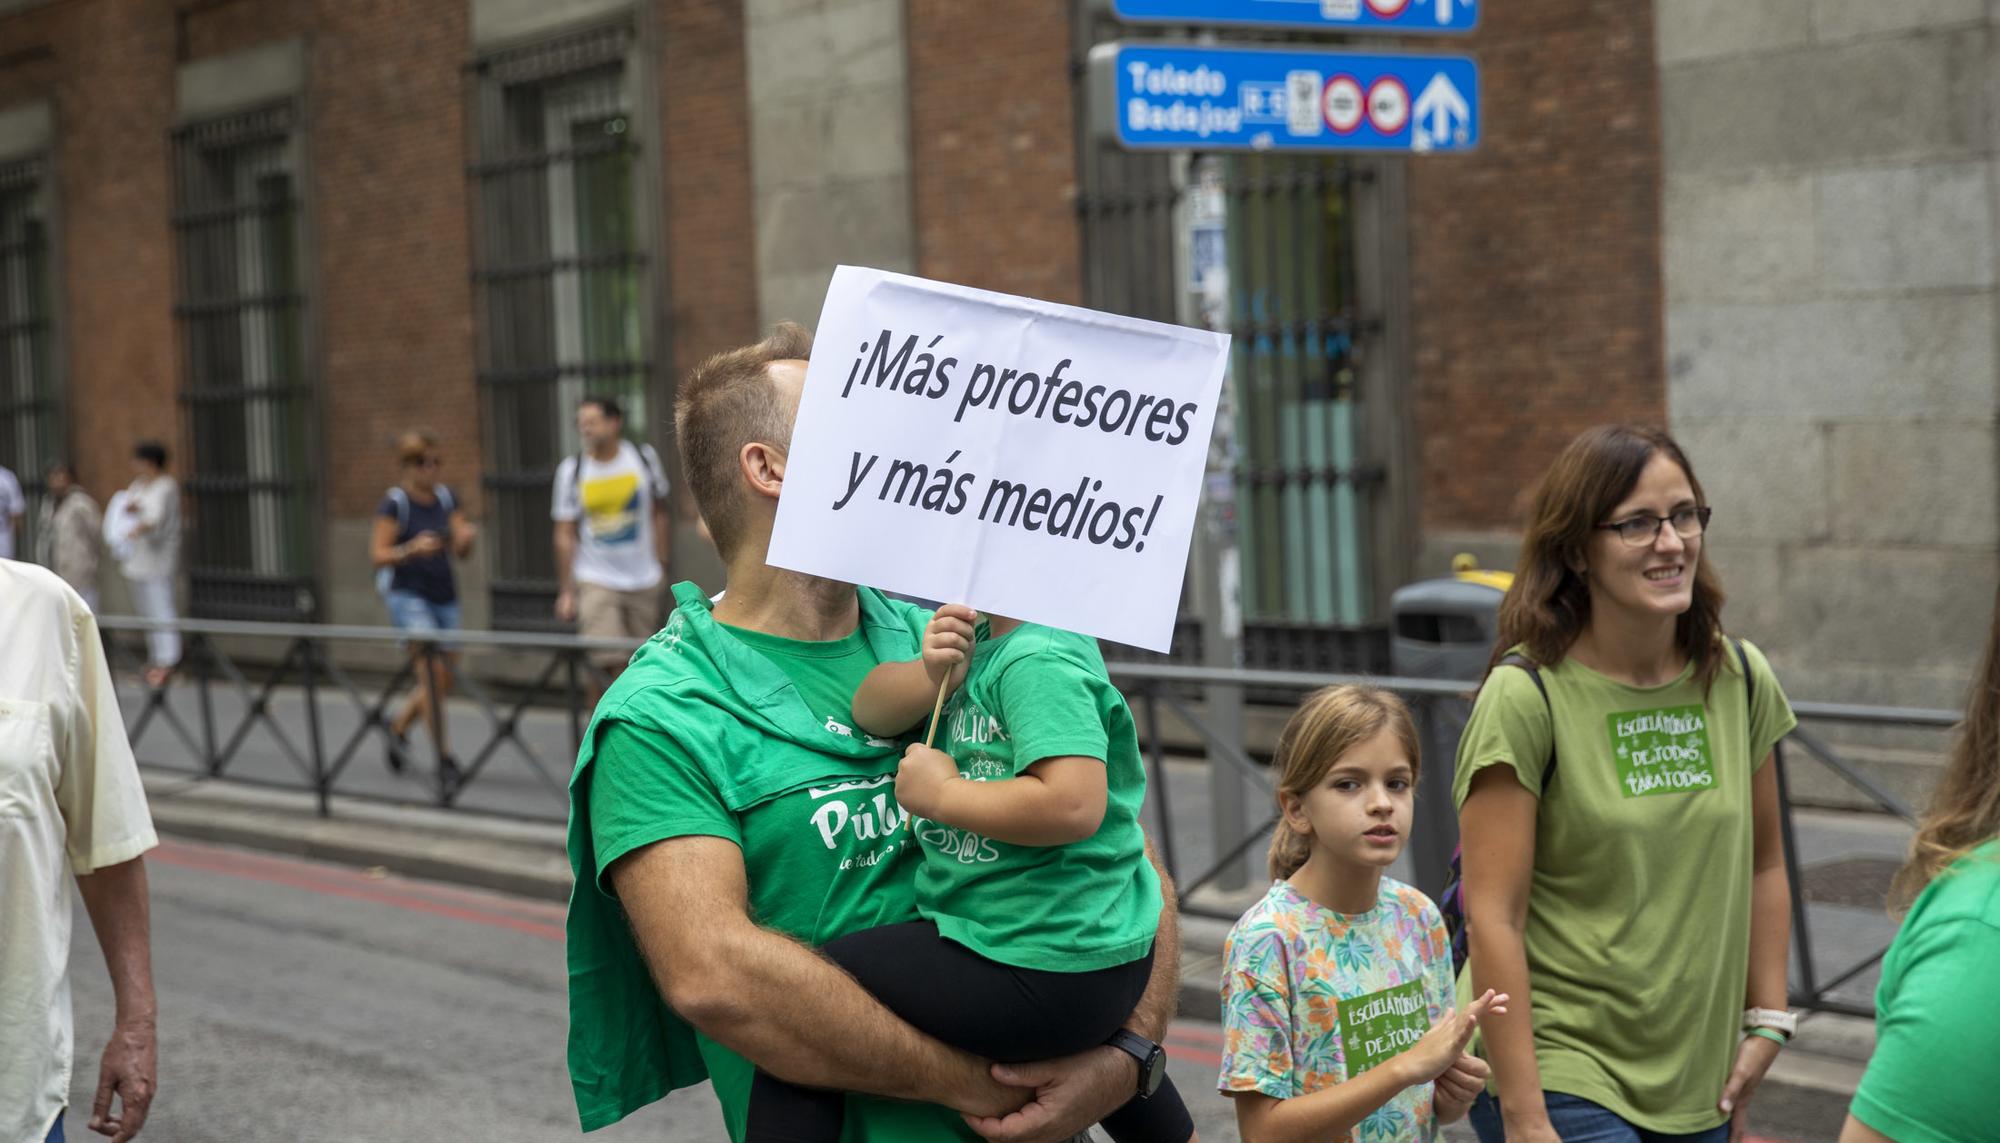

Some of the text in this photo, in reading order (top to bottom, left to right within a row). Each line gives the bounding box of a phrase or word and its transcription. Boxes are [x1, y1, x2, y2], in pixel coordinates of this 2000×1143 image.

[1127, 62, 1226, 96] Toledo
[1128, 98, 1241, 137] Badajoz
[841, 329, 1198, 446] ¡Más profesores
[831, 450, 1164, 553] y más medios!
[952, 708, 1006, 744] BLICA
[1632, 749, 1657, 767] DE
[915, 818, 1000, 864] OD@S
[1349, 996, 1395, 1026] ESCUELA
[1365, 1037, 1390, 1057] DE
